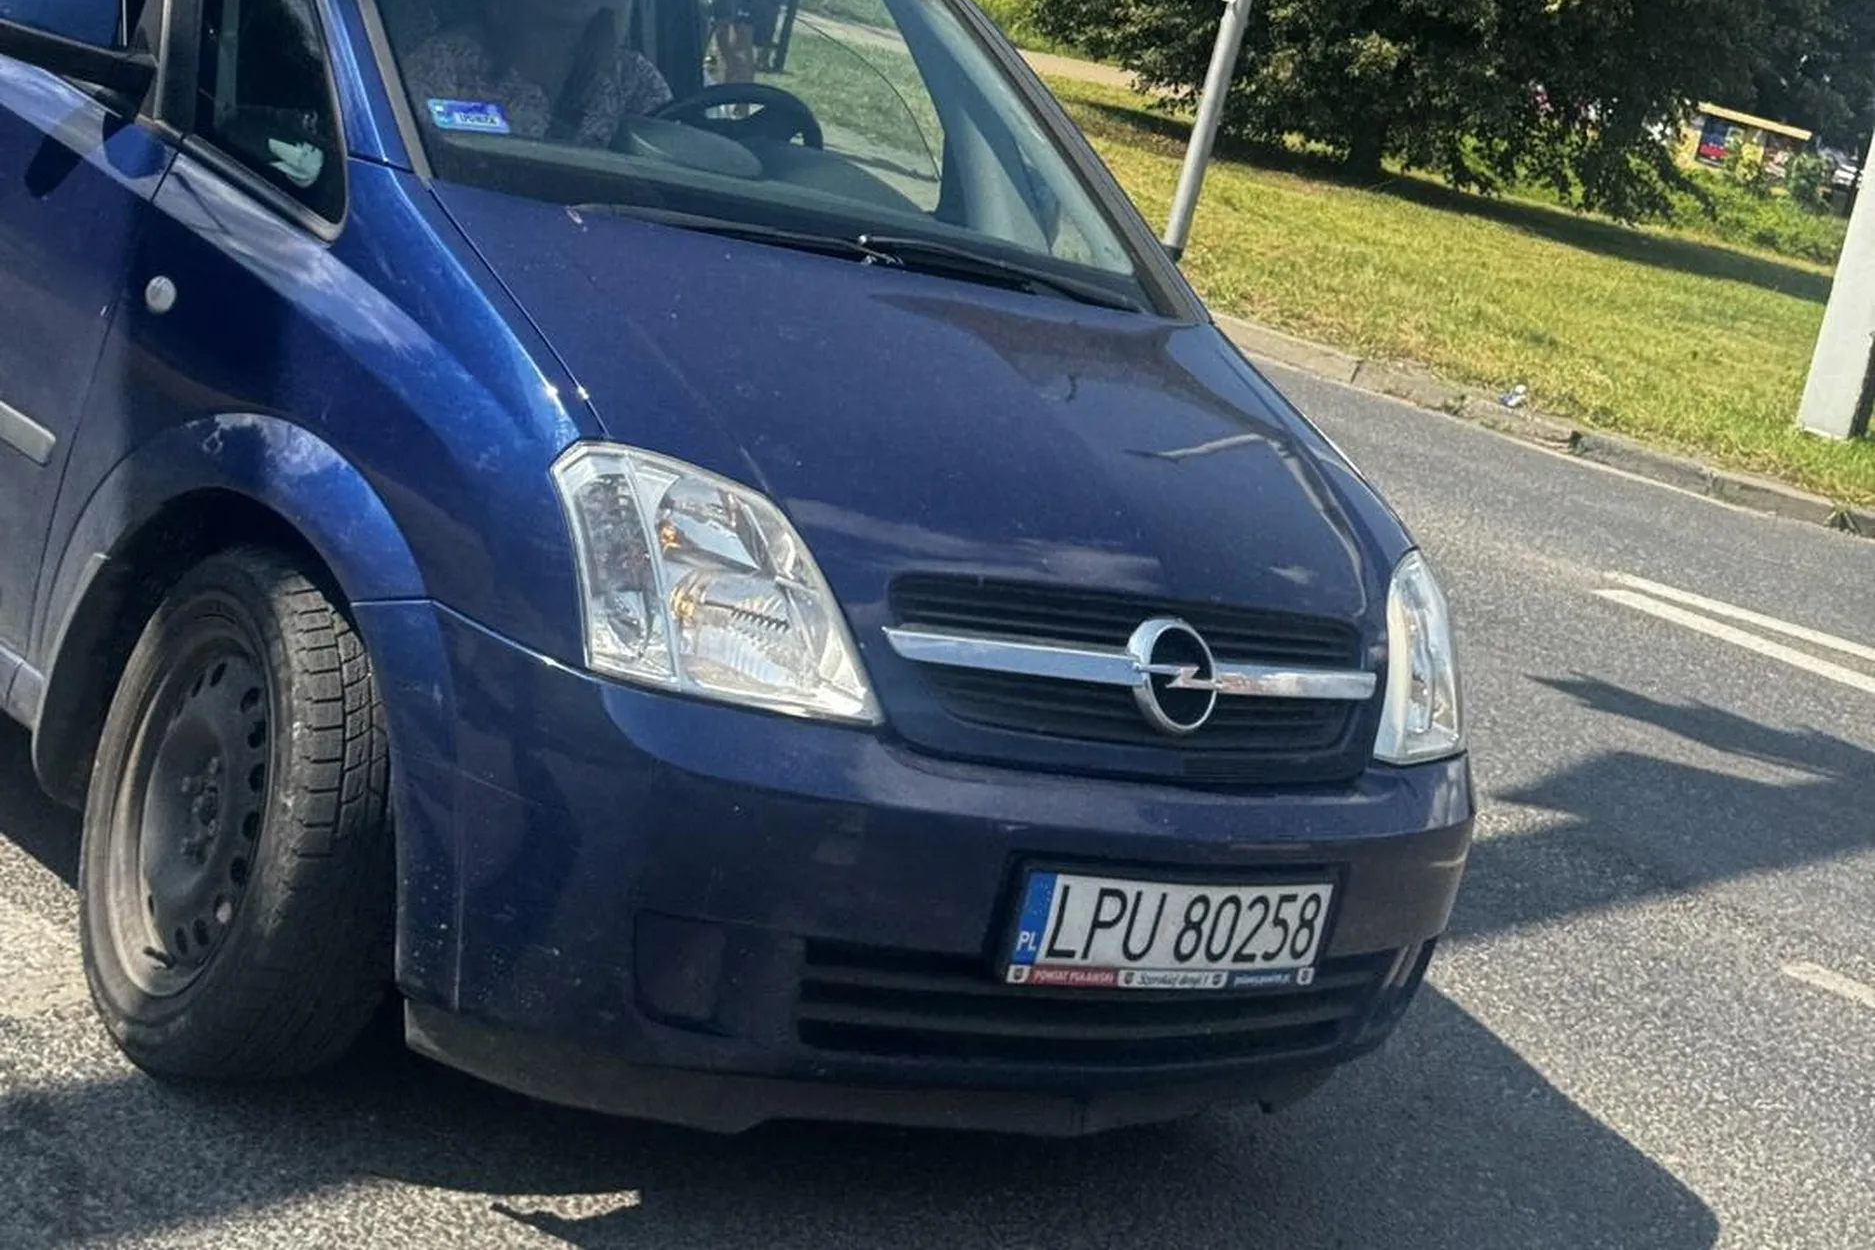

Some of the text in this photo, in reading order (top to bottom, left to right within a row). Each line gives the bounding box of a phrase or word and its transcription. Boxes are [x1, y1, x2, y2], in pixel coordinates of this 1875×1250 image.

[1016, 931, 1037, 951] PL
[1045, 885, 1322, 963] LPU 80258
